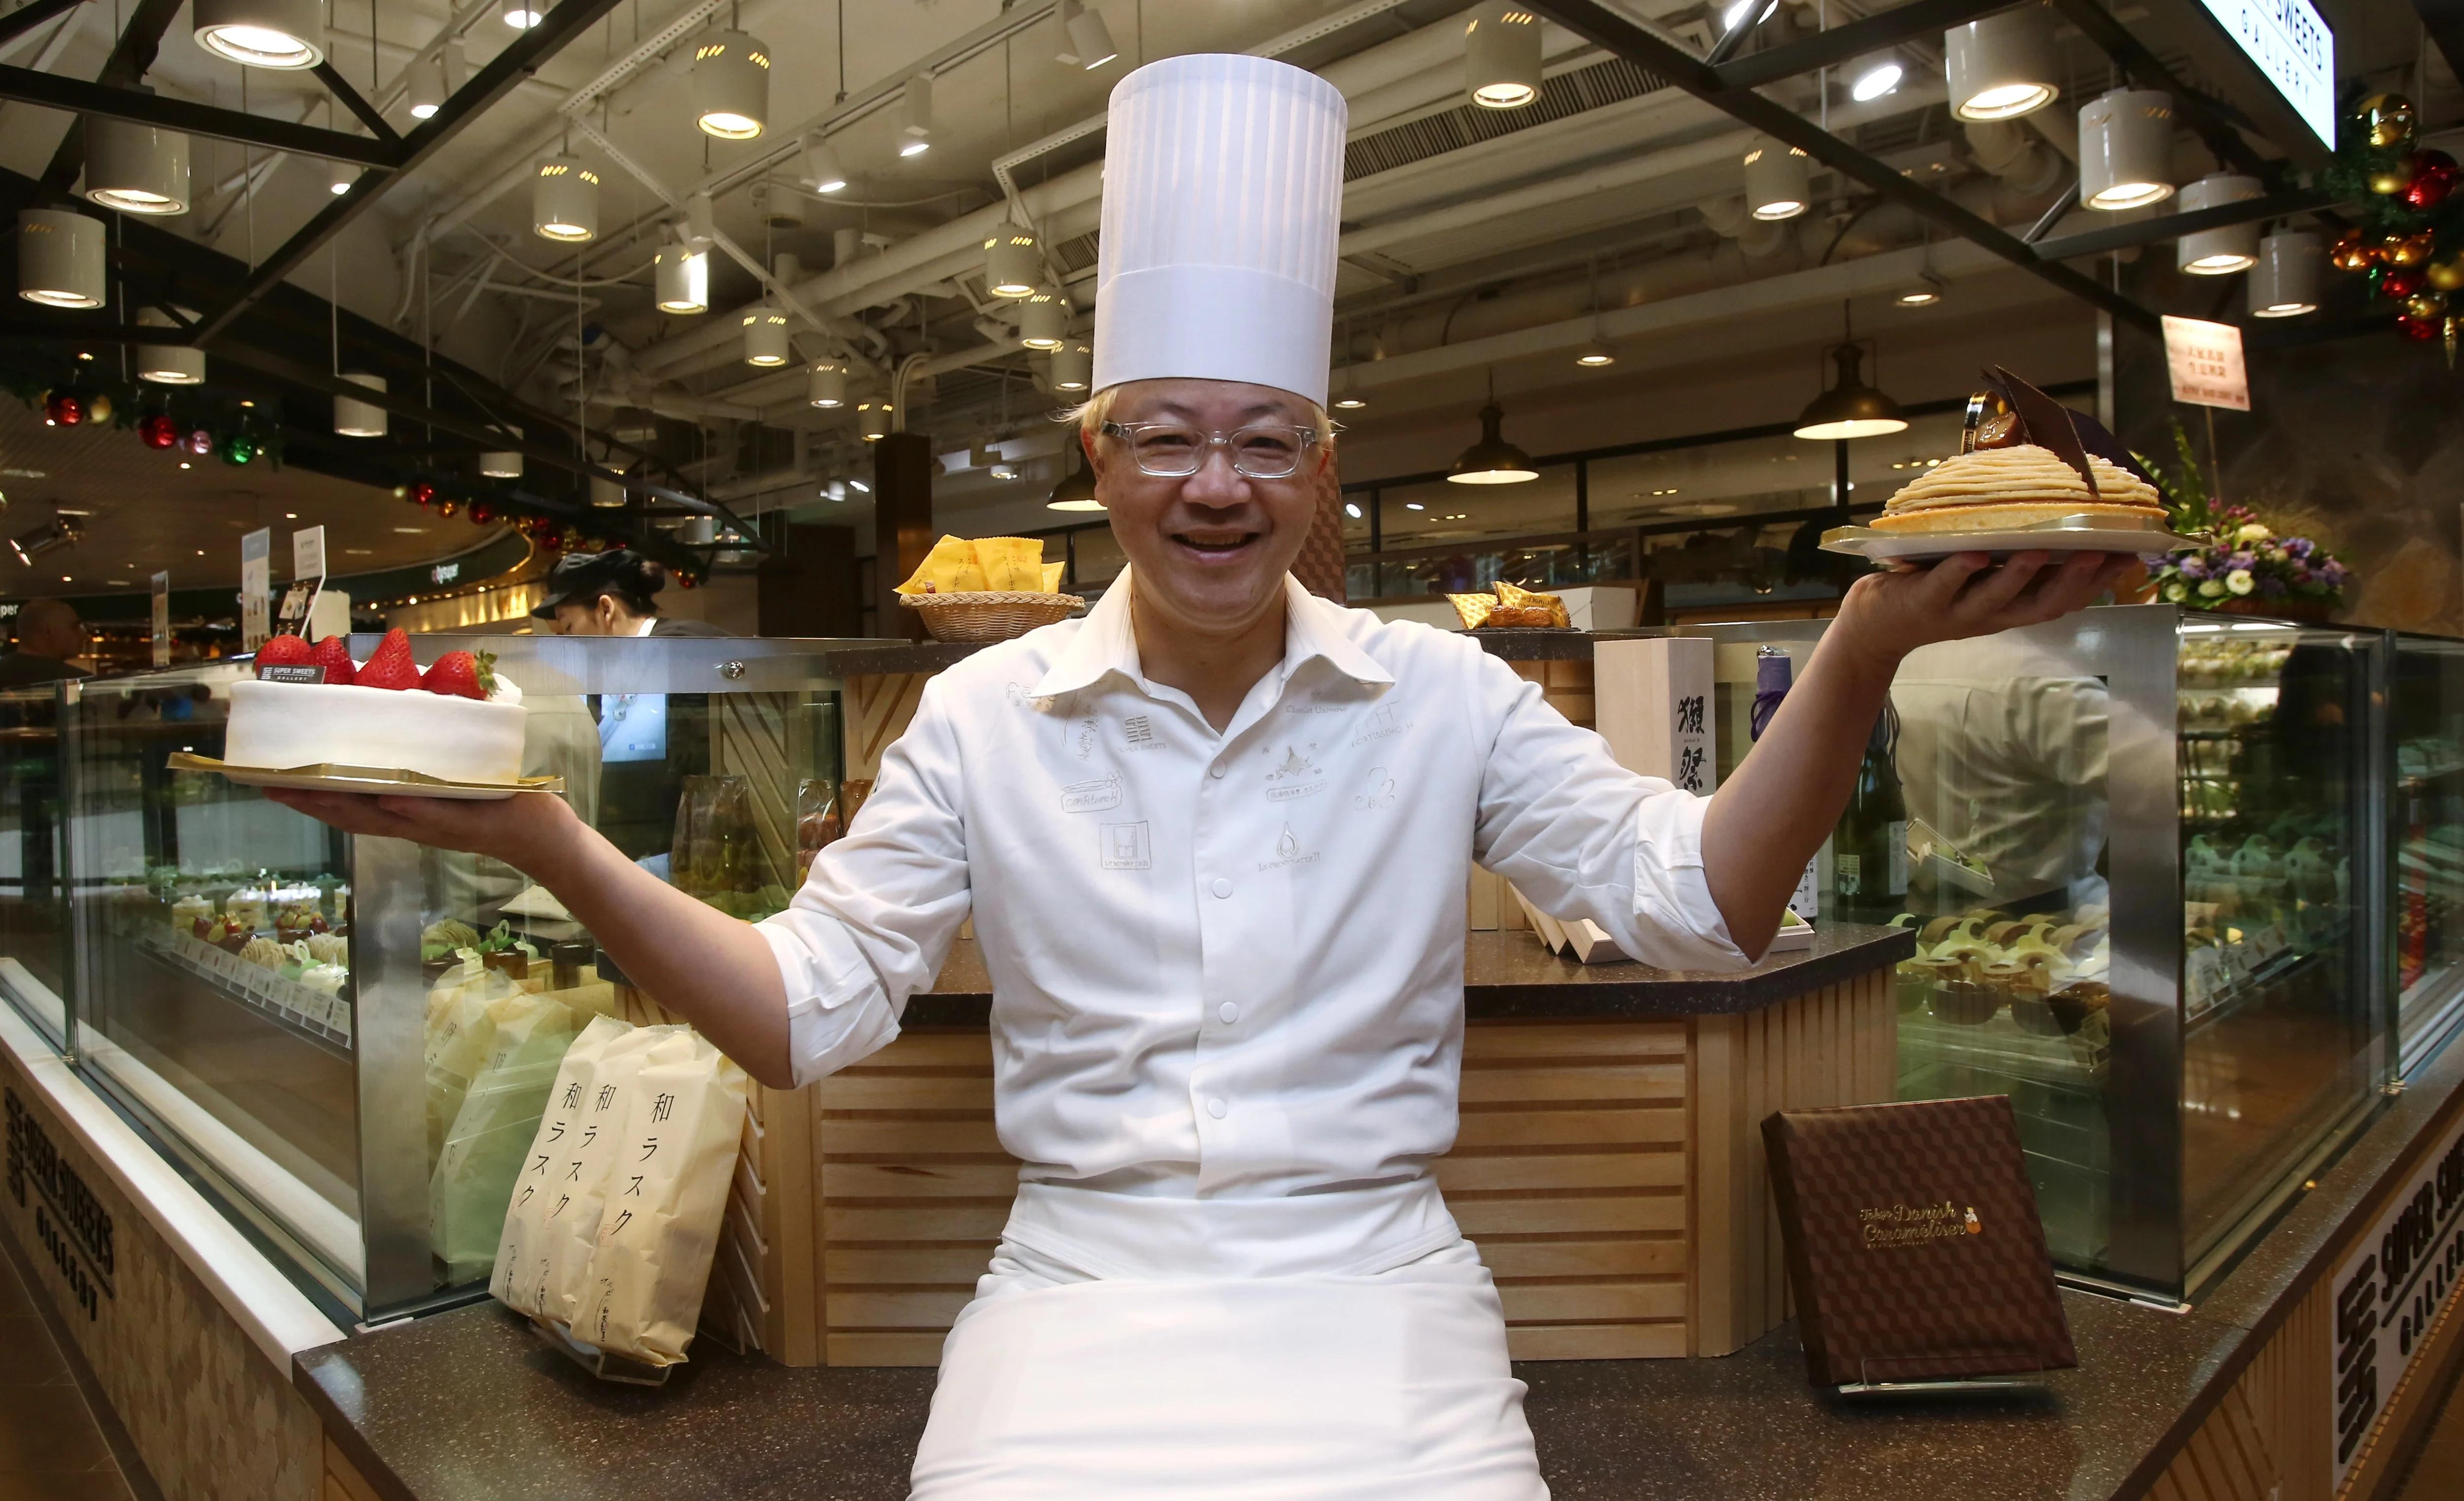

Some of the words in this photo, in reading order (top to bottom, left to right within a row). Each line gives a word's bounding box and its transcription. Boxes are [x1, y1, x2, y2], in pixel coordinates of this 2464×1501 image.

[2242, 8, 2309, 103] GALLERY
[518, 1082, 582, 1207] 和ラスク
[550, 1084, 616, 1218] 和ラスク
[612, 1093, 674, 1235] 和ラスク
[1894, 1200, 1957, 1221] Danish
[2381, 1180, 2434, 1302] SUPER
